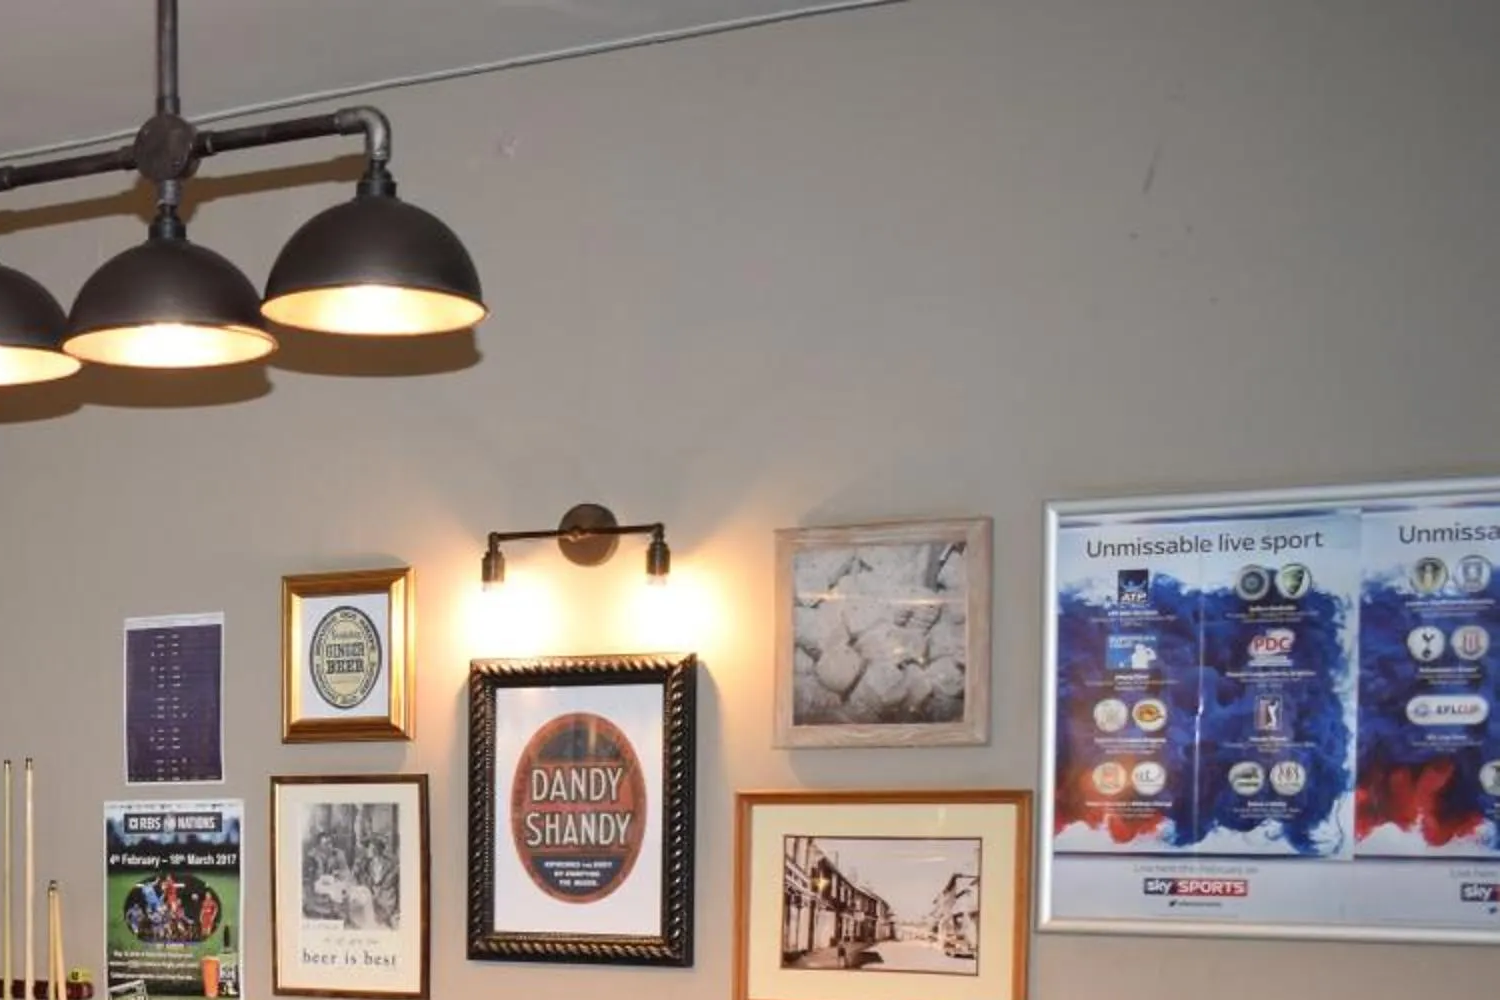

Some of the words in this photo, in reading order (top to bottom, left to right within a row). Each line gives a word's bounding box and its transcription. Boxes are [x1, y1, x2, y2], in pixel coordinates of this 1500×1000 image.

[1087, 535, 1214, 558] Unmissable
[1219, 534, 1255, 552] live
[1258, 531, 1323, 555] sport
[325, 642, 365, 658] GINGER
[1254, 636, 1293, 653] PDC
[325, 659, 365, 674] BEER
[532, 767, 623, 801] DANDY
[526, 813, 632, 846] SHANDY
[121, 854, 160, 868] February
[187, 854, 214, 865] March
[216, 854, 237, 865] 2017
[1147, 880, 1173, 896] sky
[1177, 880, 1246, 894] SPORTS
[302, 948, 337, 965] beer
[345, 950, 357, 965] is
[363, 948, 396, 966] best
